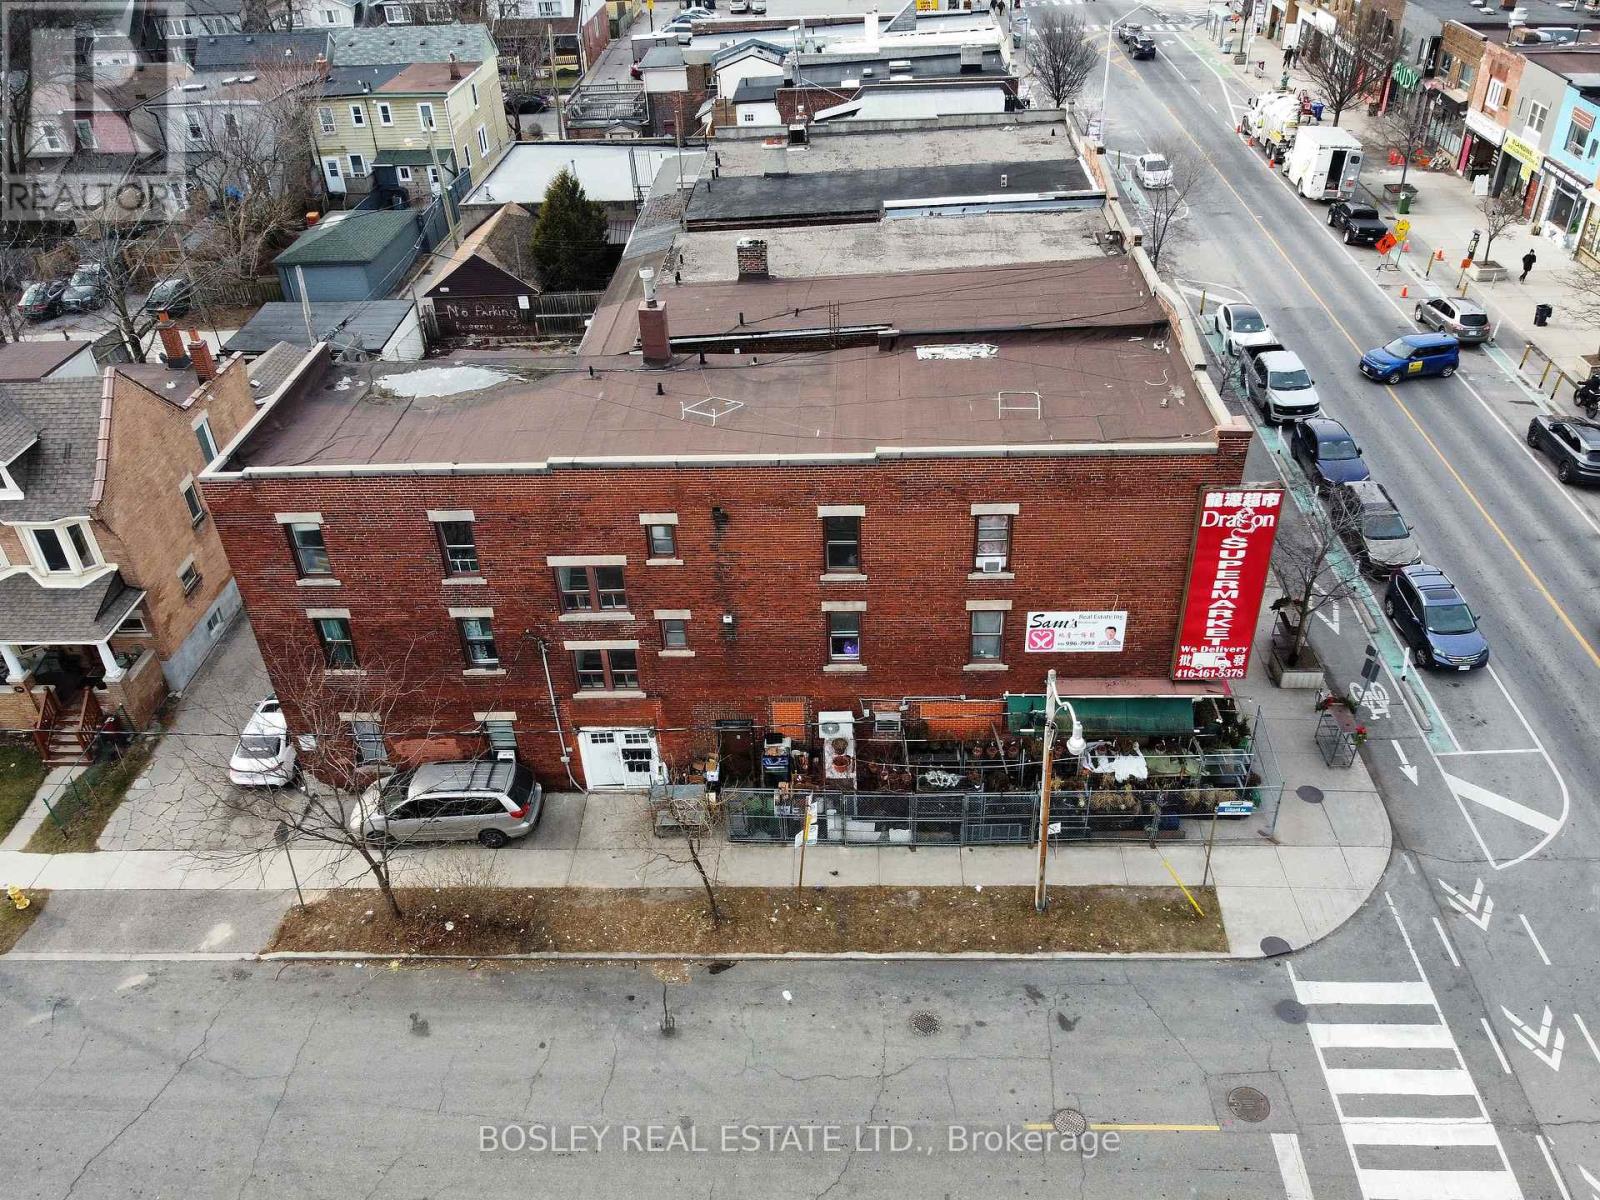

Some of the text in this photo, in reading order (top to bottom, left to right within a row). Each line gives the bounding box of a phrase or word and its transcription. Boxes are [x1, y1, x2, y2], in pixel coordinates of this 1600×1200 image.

[1394, 62, 1419, 92] RUDY
[447, 305, 518, 323] No Parking
[1201, 509, 1274, 531] Dragon
[1204, 537, 1248, 645] SUPERMARKET
[1030, 613, 1078, 628] Sam's
[1180, 645, 1249, 655] We Delivery
[1175, 668, 1244, 678] 416-461-5378
